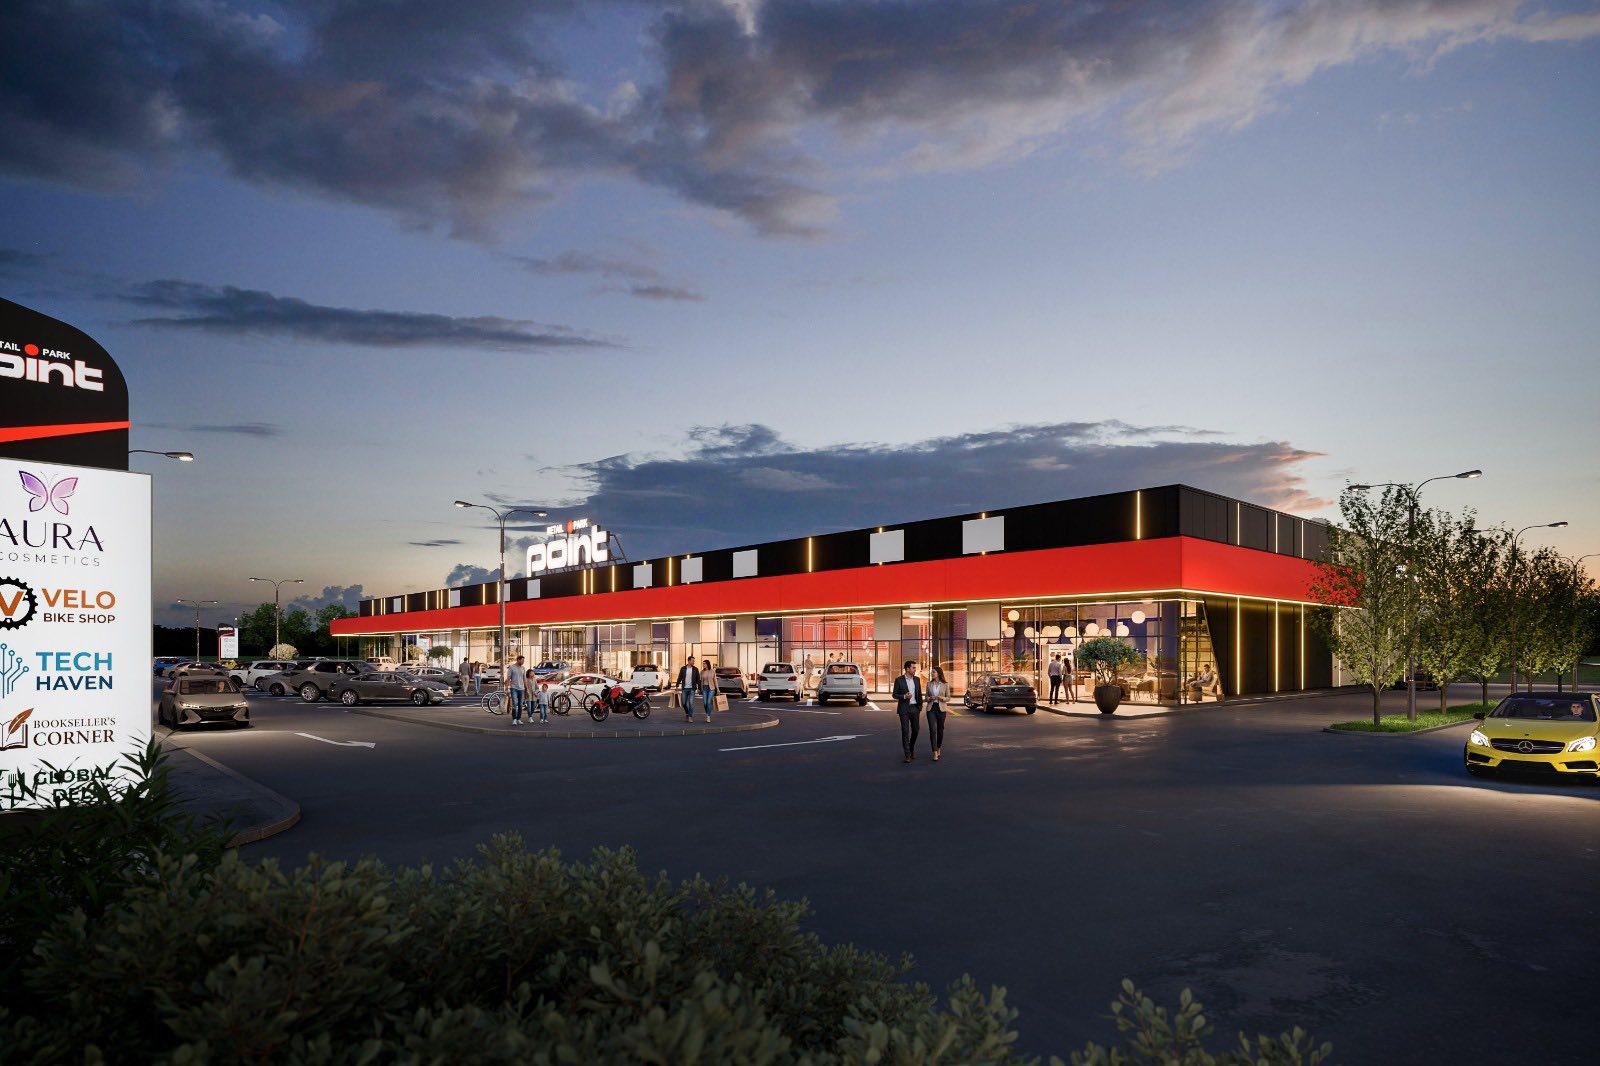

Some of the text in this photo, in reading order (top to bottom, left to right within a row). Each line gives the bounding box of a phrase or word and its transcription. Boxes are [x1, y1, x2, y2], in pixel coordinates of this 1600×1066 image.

[42, 348, 71, 360] PARK
[573, 518, 588, 531] PARK
[0, 518, 104, 552] AURA
[526, 520, 609, 578] point
[41, 588, 116, 610] VELO
[43, 612, 116, 624] BIKE SHOP
[35, 651, 113, 672] TECH
[36, 675, 113, 691] HAVEN
[33, 717, 116, 729] BOOKSELLER'S
[33, 729, 116, 747] CORNER
[34, 768, 116, 785] GLOBAL
[52, 787, 98, 802] DEL
